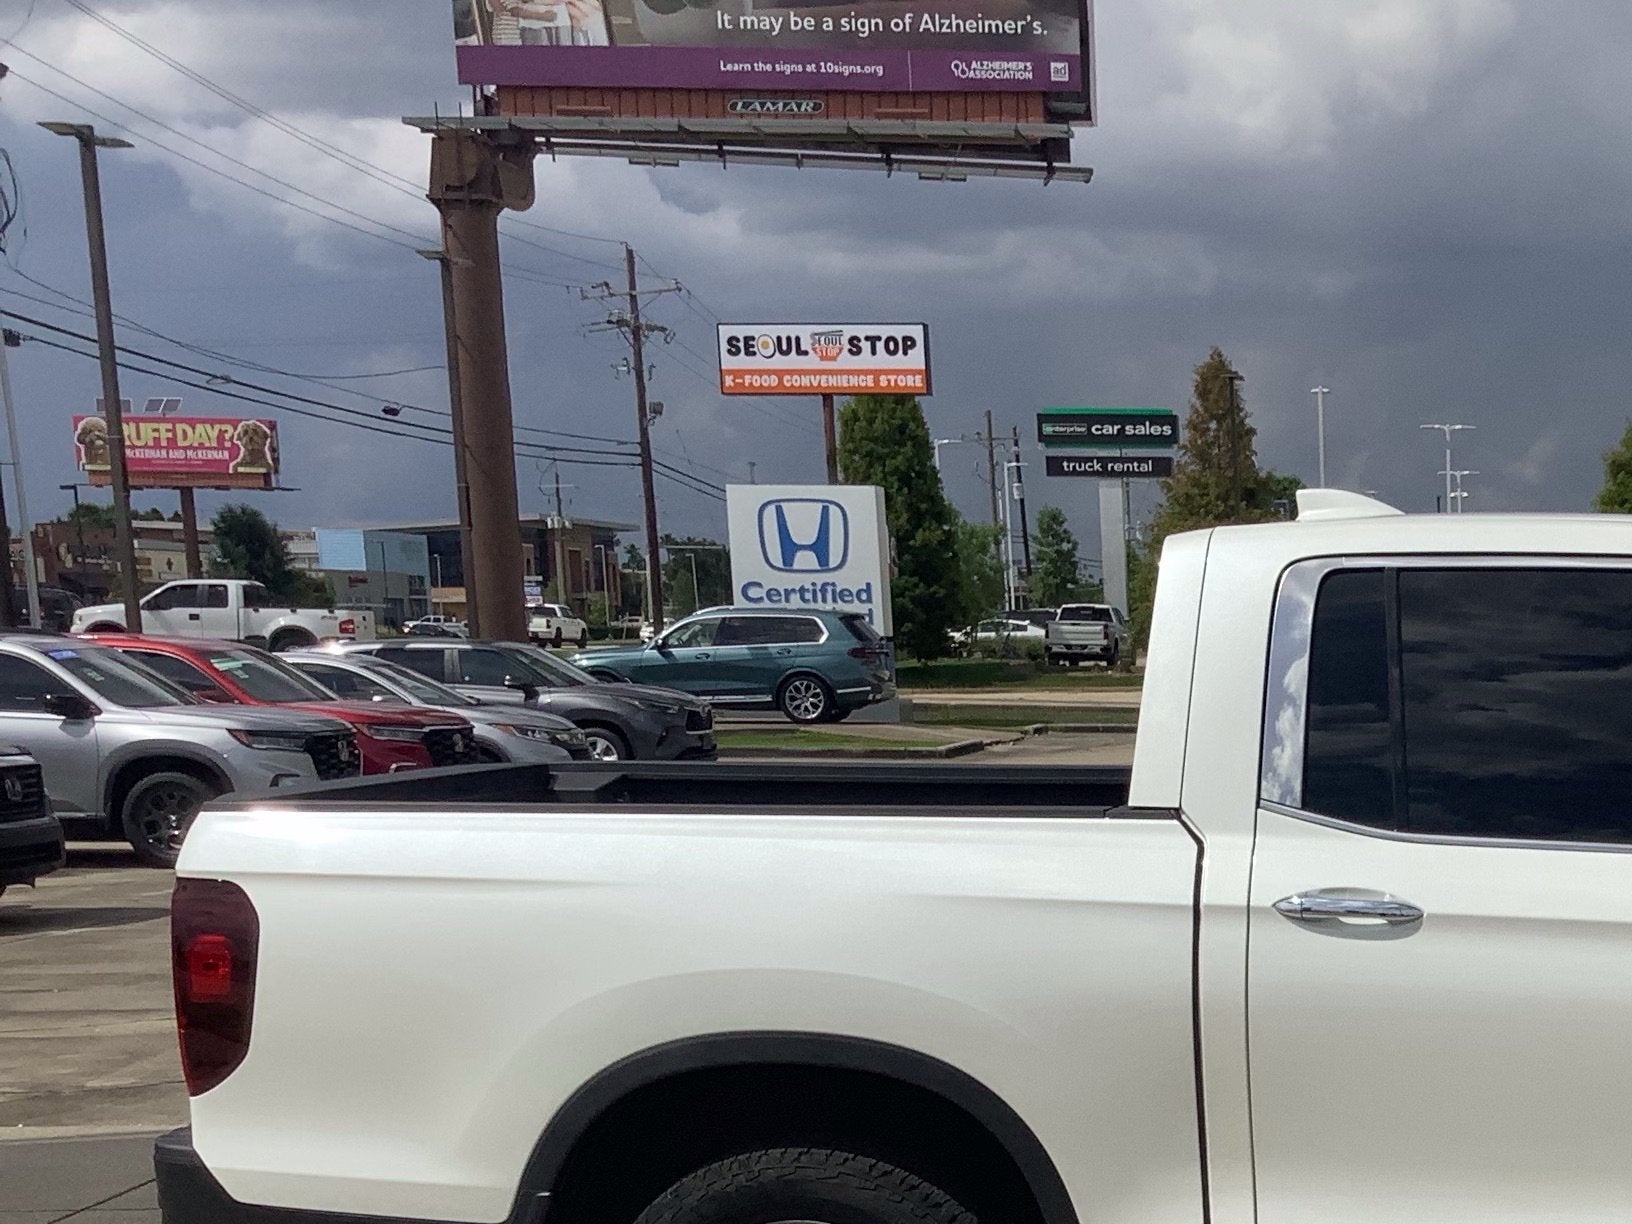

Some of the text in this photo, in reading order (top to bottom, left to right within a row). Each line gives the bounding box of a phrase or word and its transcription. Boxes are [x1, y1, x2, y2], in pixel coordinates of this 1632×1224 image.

[717, 10, 1048, 37] It may be a sign of Alzheimer's.
[720, 60, 884, 77] Learn the signs at 10signs.org
[970, 60, 1033, 70] ALZHEIMER'S
[968, 70, 1033, 80] ASSOCIATION
[735, 101, 815, 113] LAMAR
[726, 334, 917, 359] SEOUL STOP
[724, 375, 923, 388] K-FOOD CONVENIENCE STORE
[176, 422, 234, 448] DAY?
[1091, 424, 1121, 436] car
[1125, 420, 1173, 436] sales
[1062, 458, 1153, 473] truck rental
[741, 580, 873, 604] Certified
